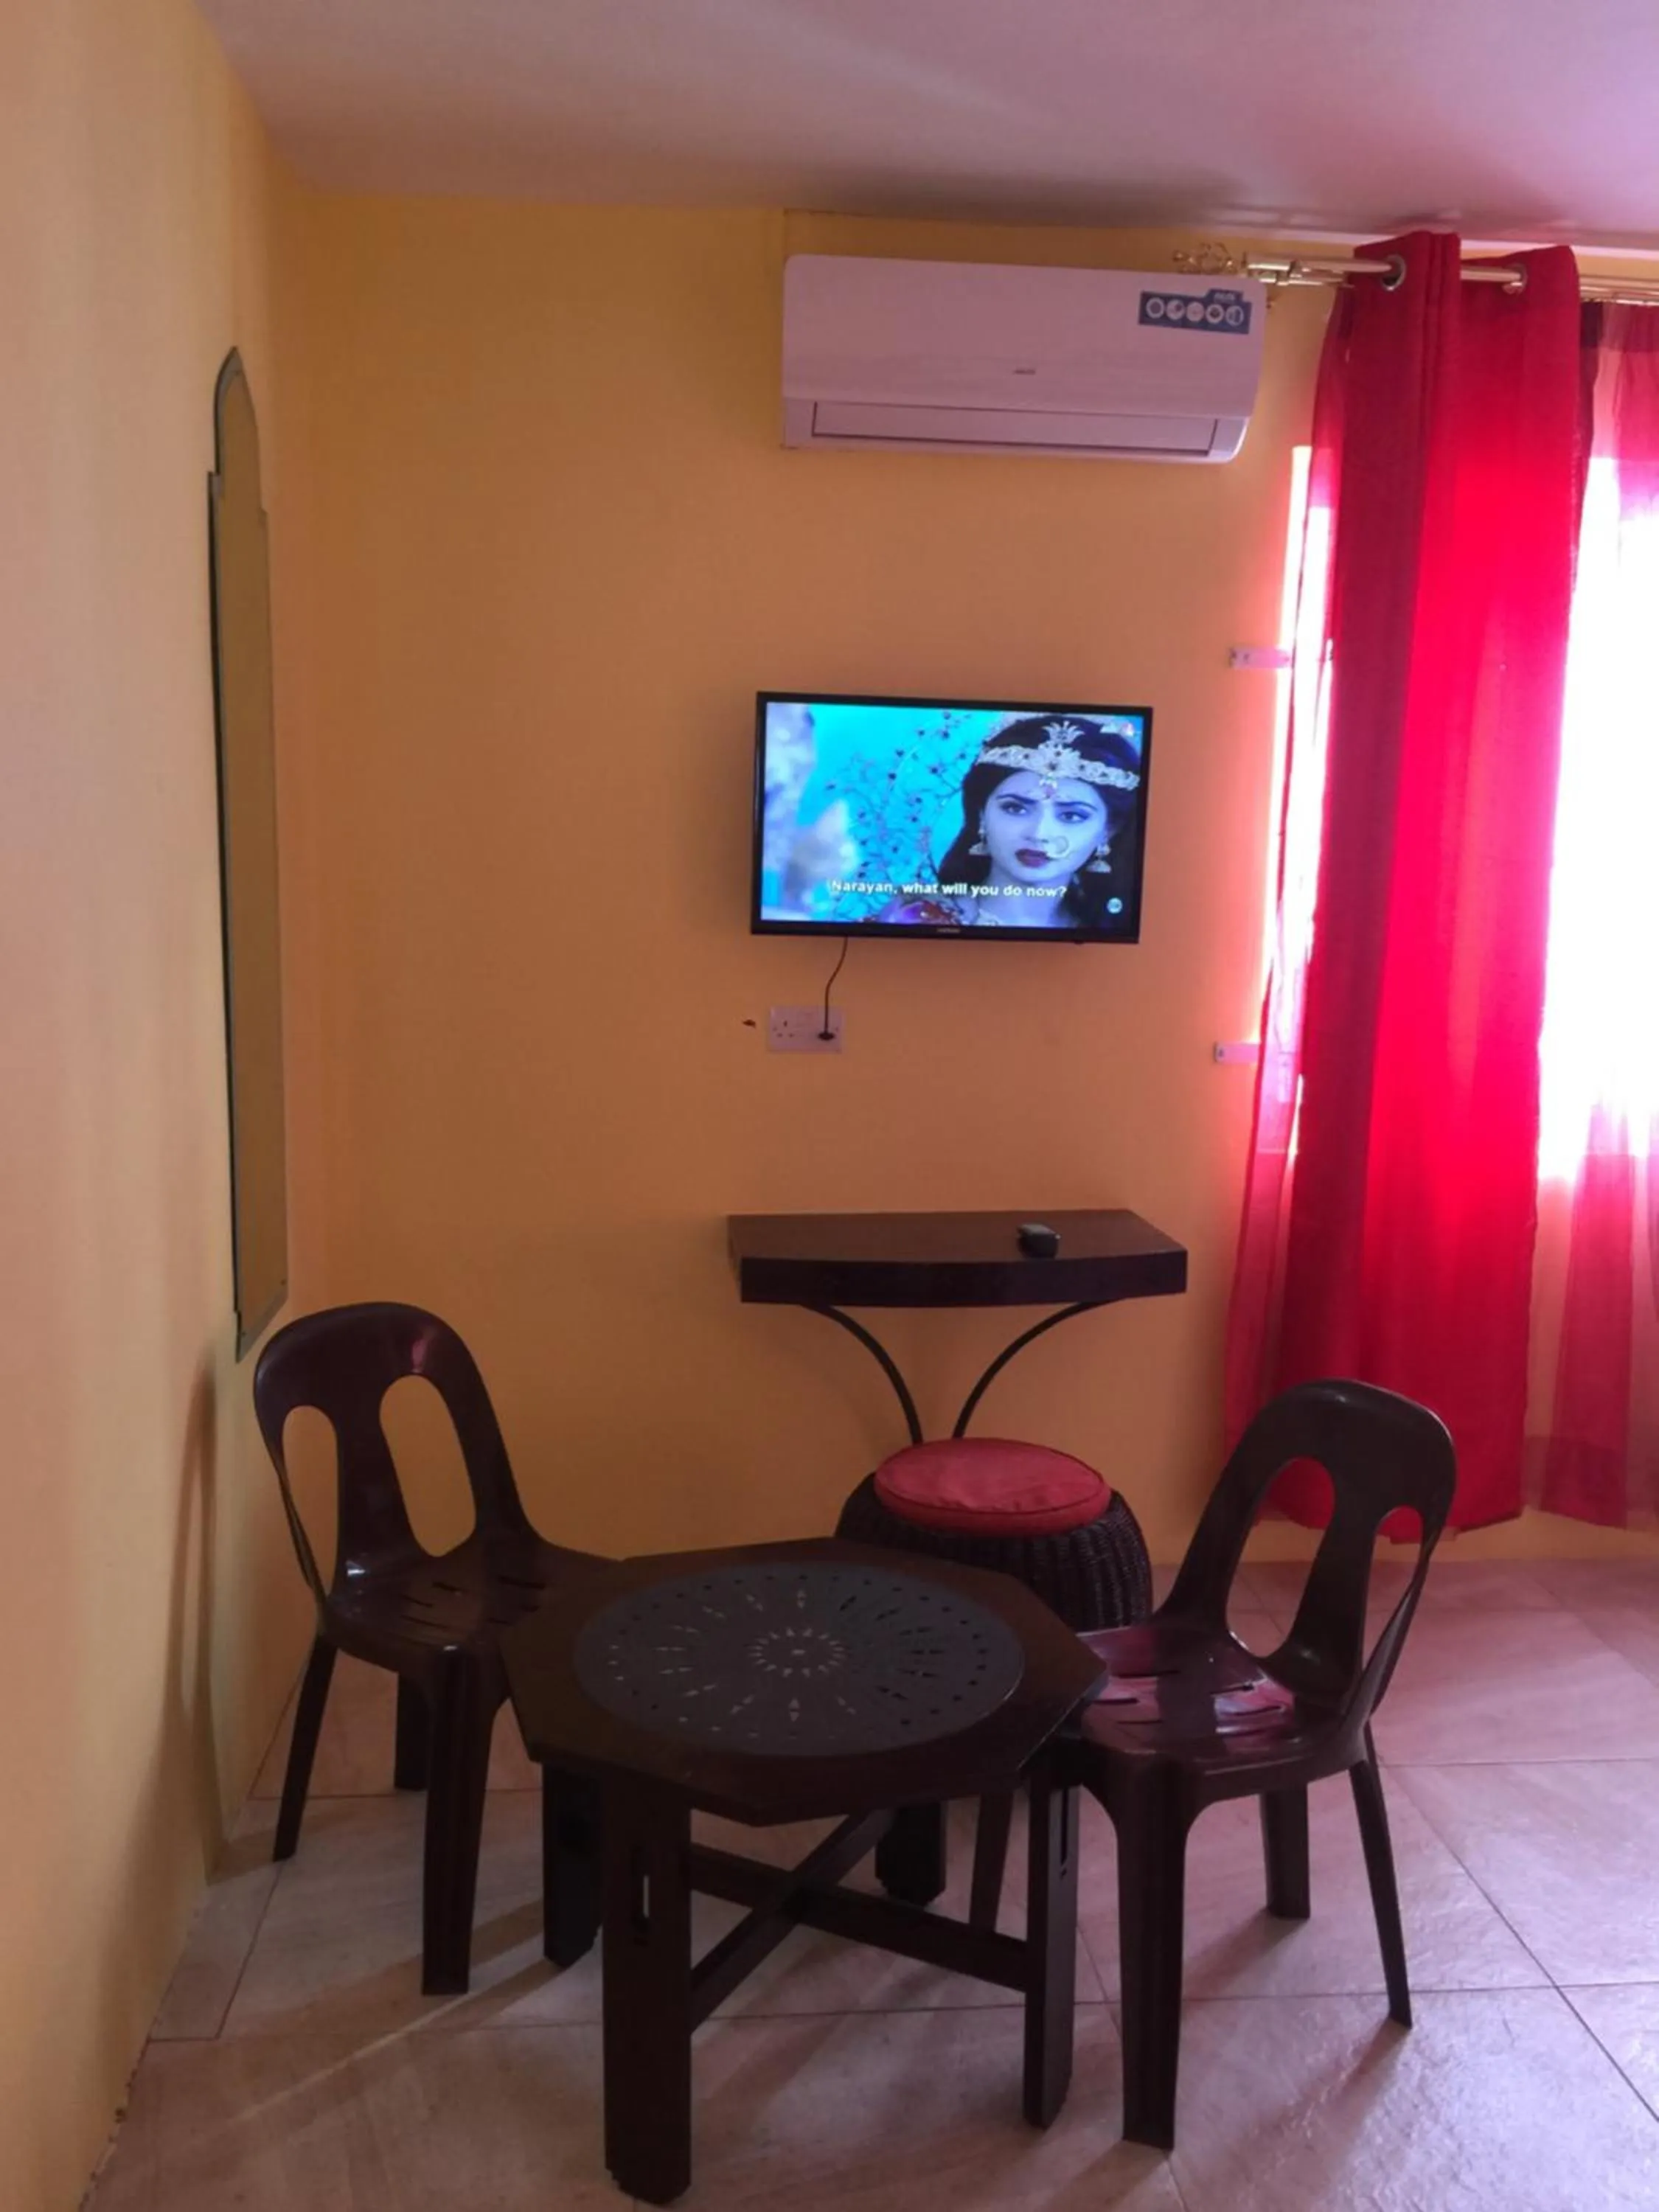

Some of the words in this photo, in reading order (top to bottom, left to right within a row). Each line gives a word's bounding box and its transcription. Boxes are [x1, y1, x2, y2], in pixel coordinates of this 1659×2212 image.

[831, 880, 897, 894] Narayan,
[902, 883, 939, 894] what
[941, 883, 967, 894] will
[970, 886, 999, 897] you
[1003, 885, 1022, 896] do
[1026, 886, 1067, 897] now?
